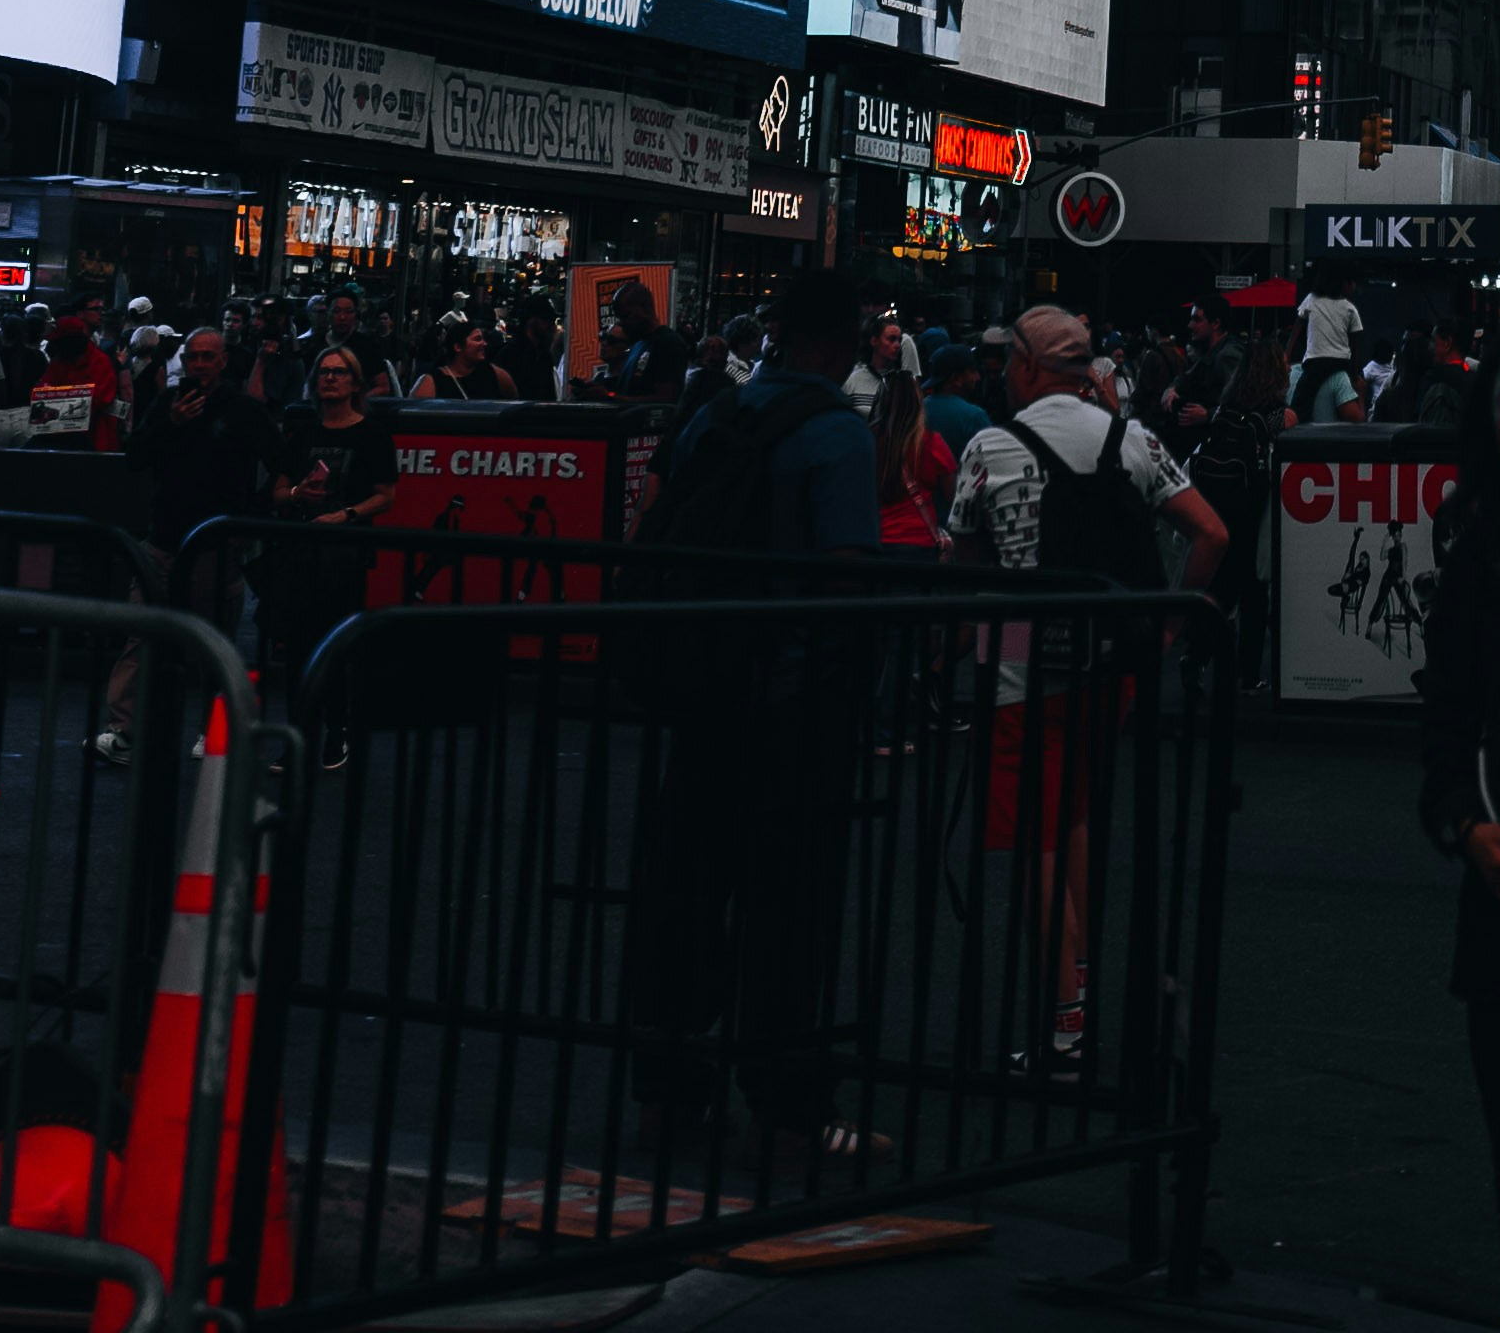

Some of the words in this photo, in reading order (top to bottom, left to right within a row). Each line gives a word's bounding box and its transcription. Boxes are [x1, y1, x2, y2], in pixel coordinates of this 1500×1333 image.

[286, 32, 330, 67] SPORTS
[331, 42, 355, 70] FAN
[356, 46, 386, 76] SHOP
[630, 105, 676, 130] DISCOUNT
[857, 95, 899, 139] BLUE
[905, 108, 933, 144] FIN
[633, 128, 657, 149] GIFTS
[657, 133, 666, 151] &
[854, 136, 899, 162] SEAFOOD
[901, 145, 931, 167] SUSHI
[624, 148, 674, 174] SOUVENIRS
[679, 159, 699, 185] NY
[730, 164, 738, 189] 3
[750, 188, 800, 221] HEYTEA
[1327, 216, 1477, 248] KLIKTIX
[396, 448, 443, 476] HE.
[449, 450, 585, 480] CHARTS.
